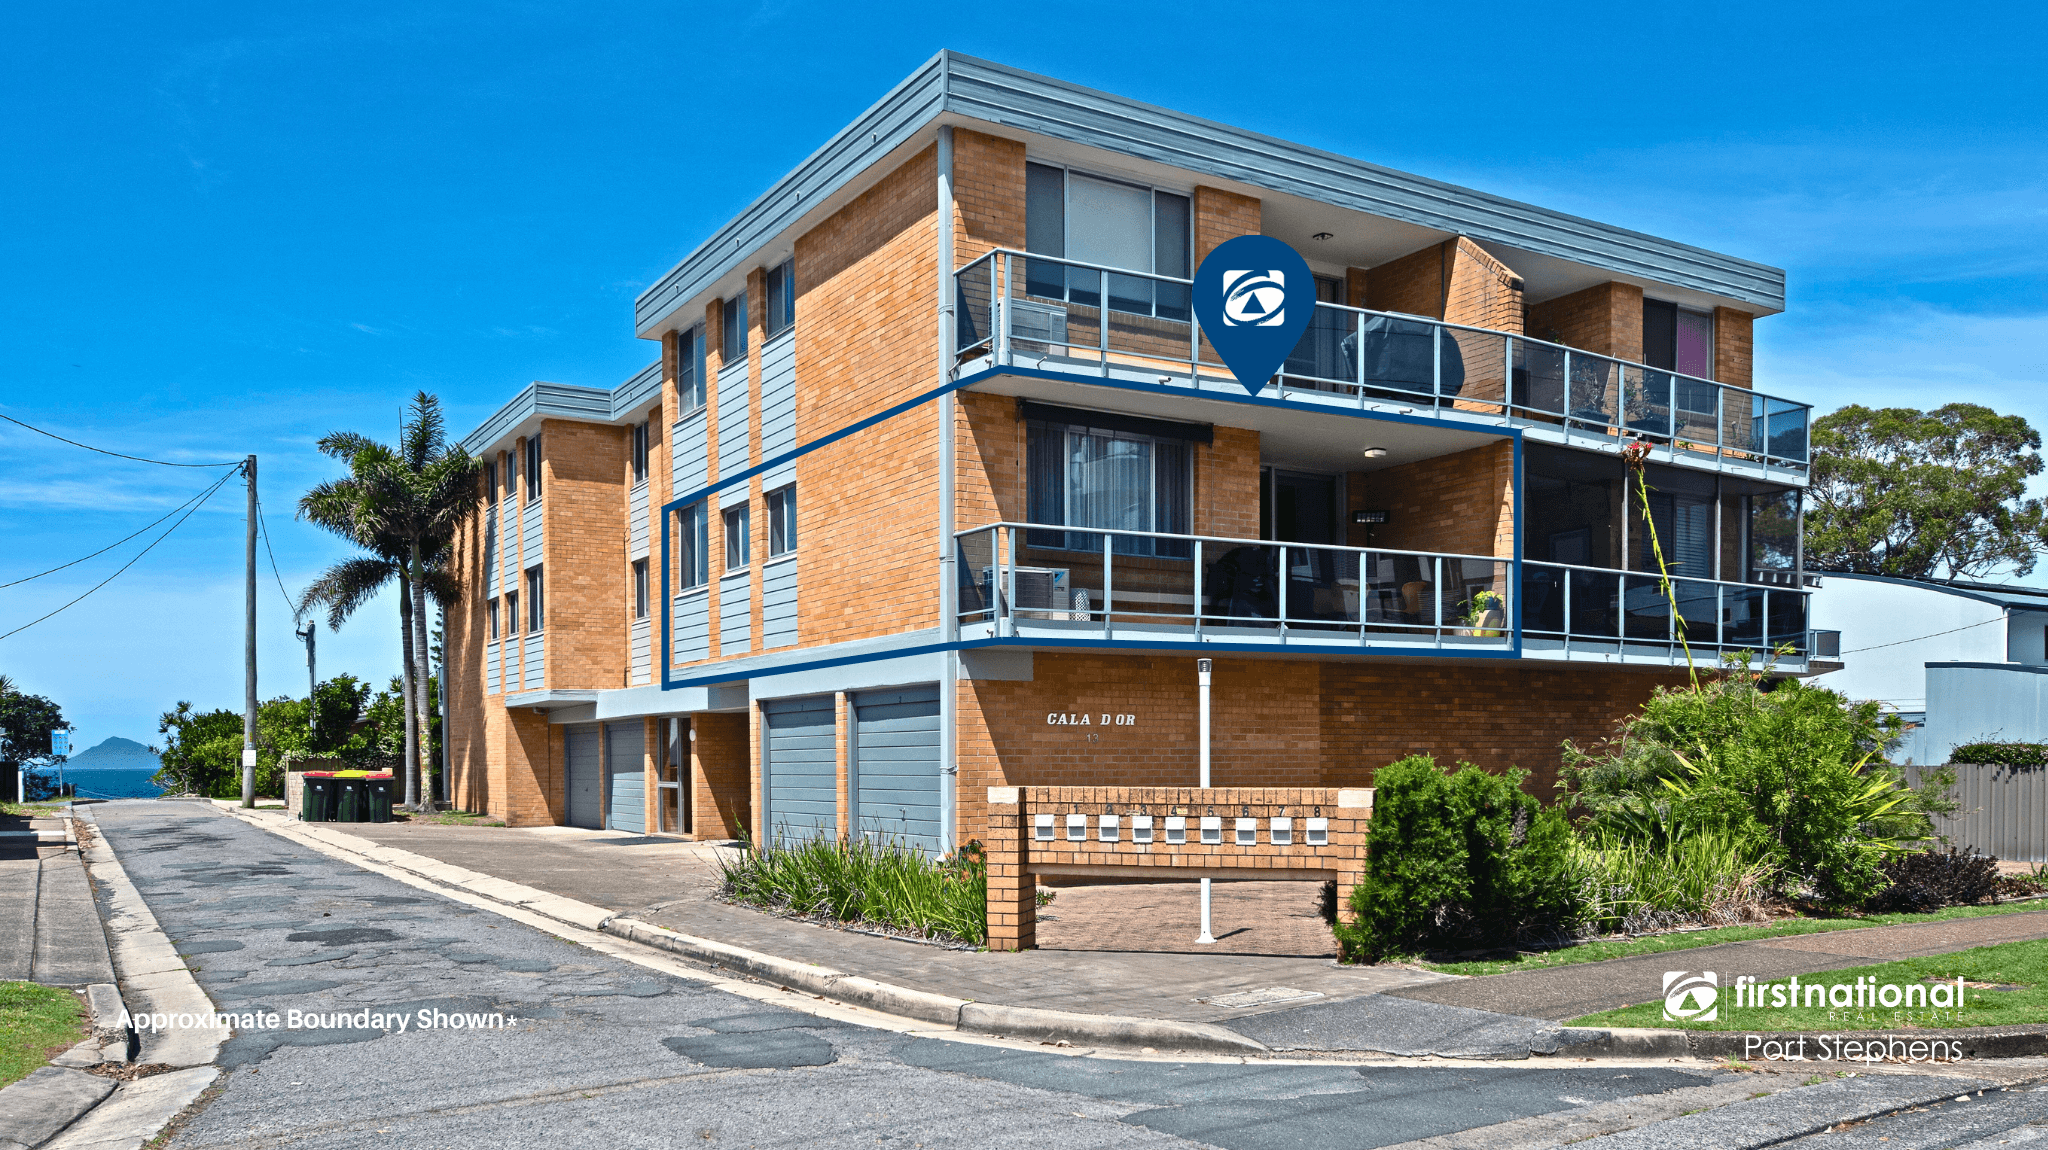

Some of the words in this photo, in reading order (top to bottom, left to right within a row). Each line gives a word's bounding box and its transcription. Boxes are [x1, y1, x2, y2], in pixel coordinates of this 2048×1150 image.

[1046, 713, 1091, 725] CALA
[1086, 733, 1099, 743] 13
[1105, 804, 1113, 815] 2
[1140, 804, 1147, 816] 3
[1170, 805, 1178, 817] 4
[1207, 806, 1215, 817] 5
[1242, 806, 1249, 818] 6
[1278, 806, 1286, 817] 7
[1313, 806, 1321, 818] 8
